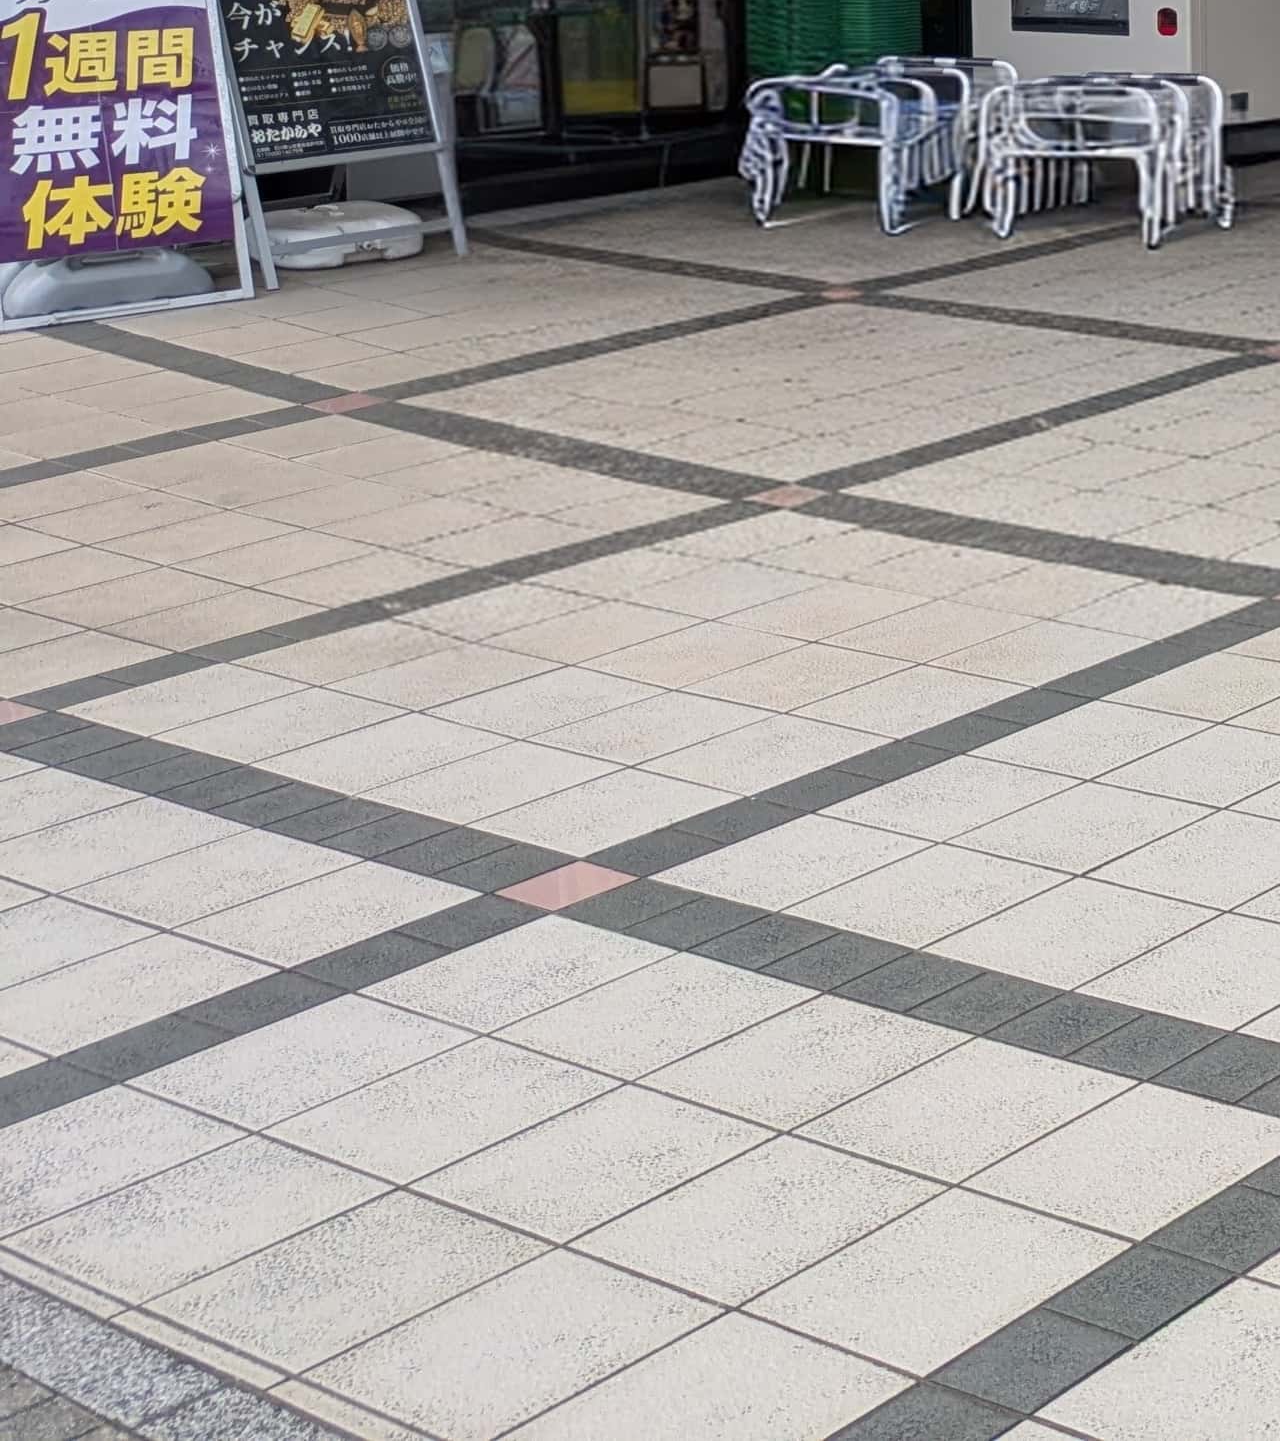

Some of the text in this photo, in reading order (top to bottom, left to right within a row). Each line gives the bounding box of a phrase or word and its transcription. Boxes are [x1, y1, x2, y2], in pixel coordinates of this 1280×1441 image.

[226, 0, 282, 31] 今が
[1, 11, 195, 101] 1週間
[233, 29, 353, 63] チャンス!
[247, 108, 320, 126] 買取専門店
[250, 122, 322, 144] おたからや
[10, 94, 198, 175] 無料
[22, 167, 206, 250] 体験
